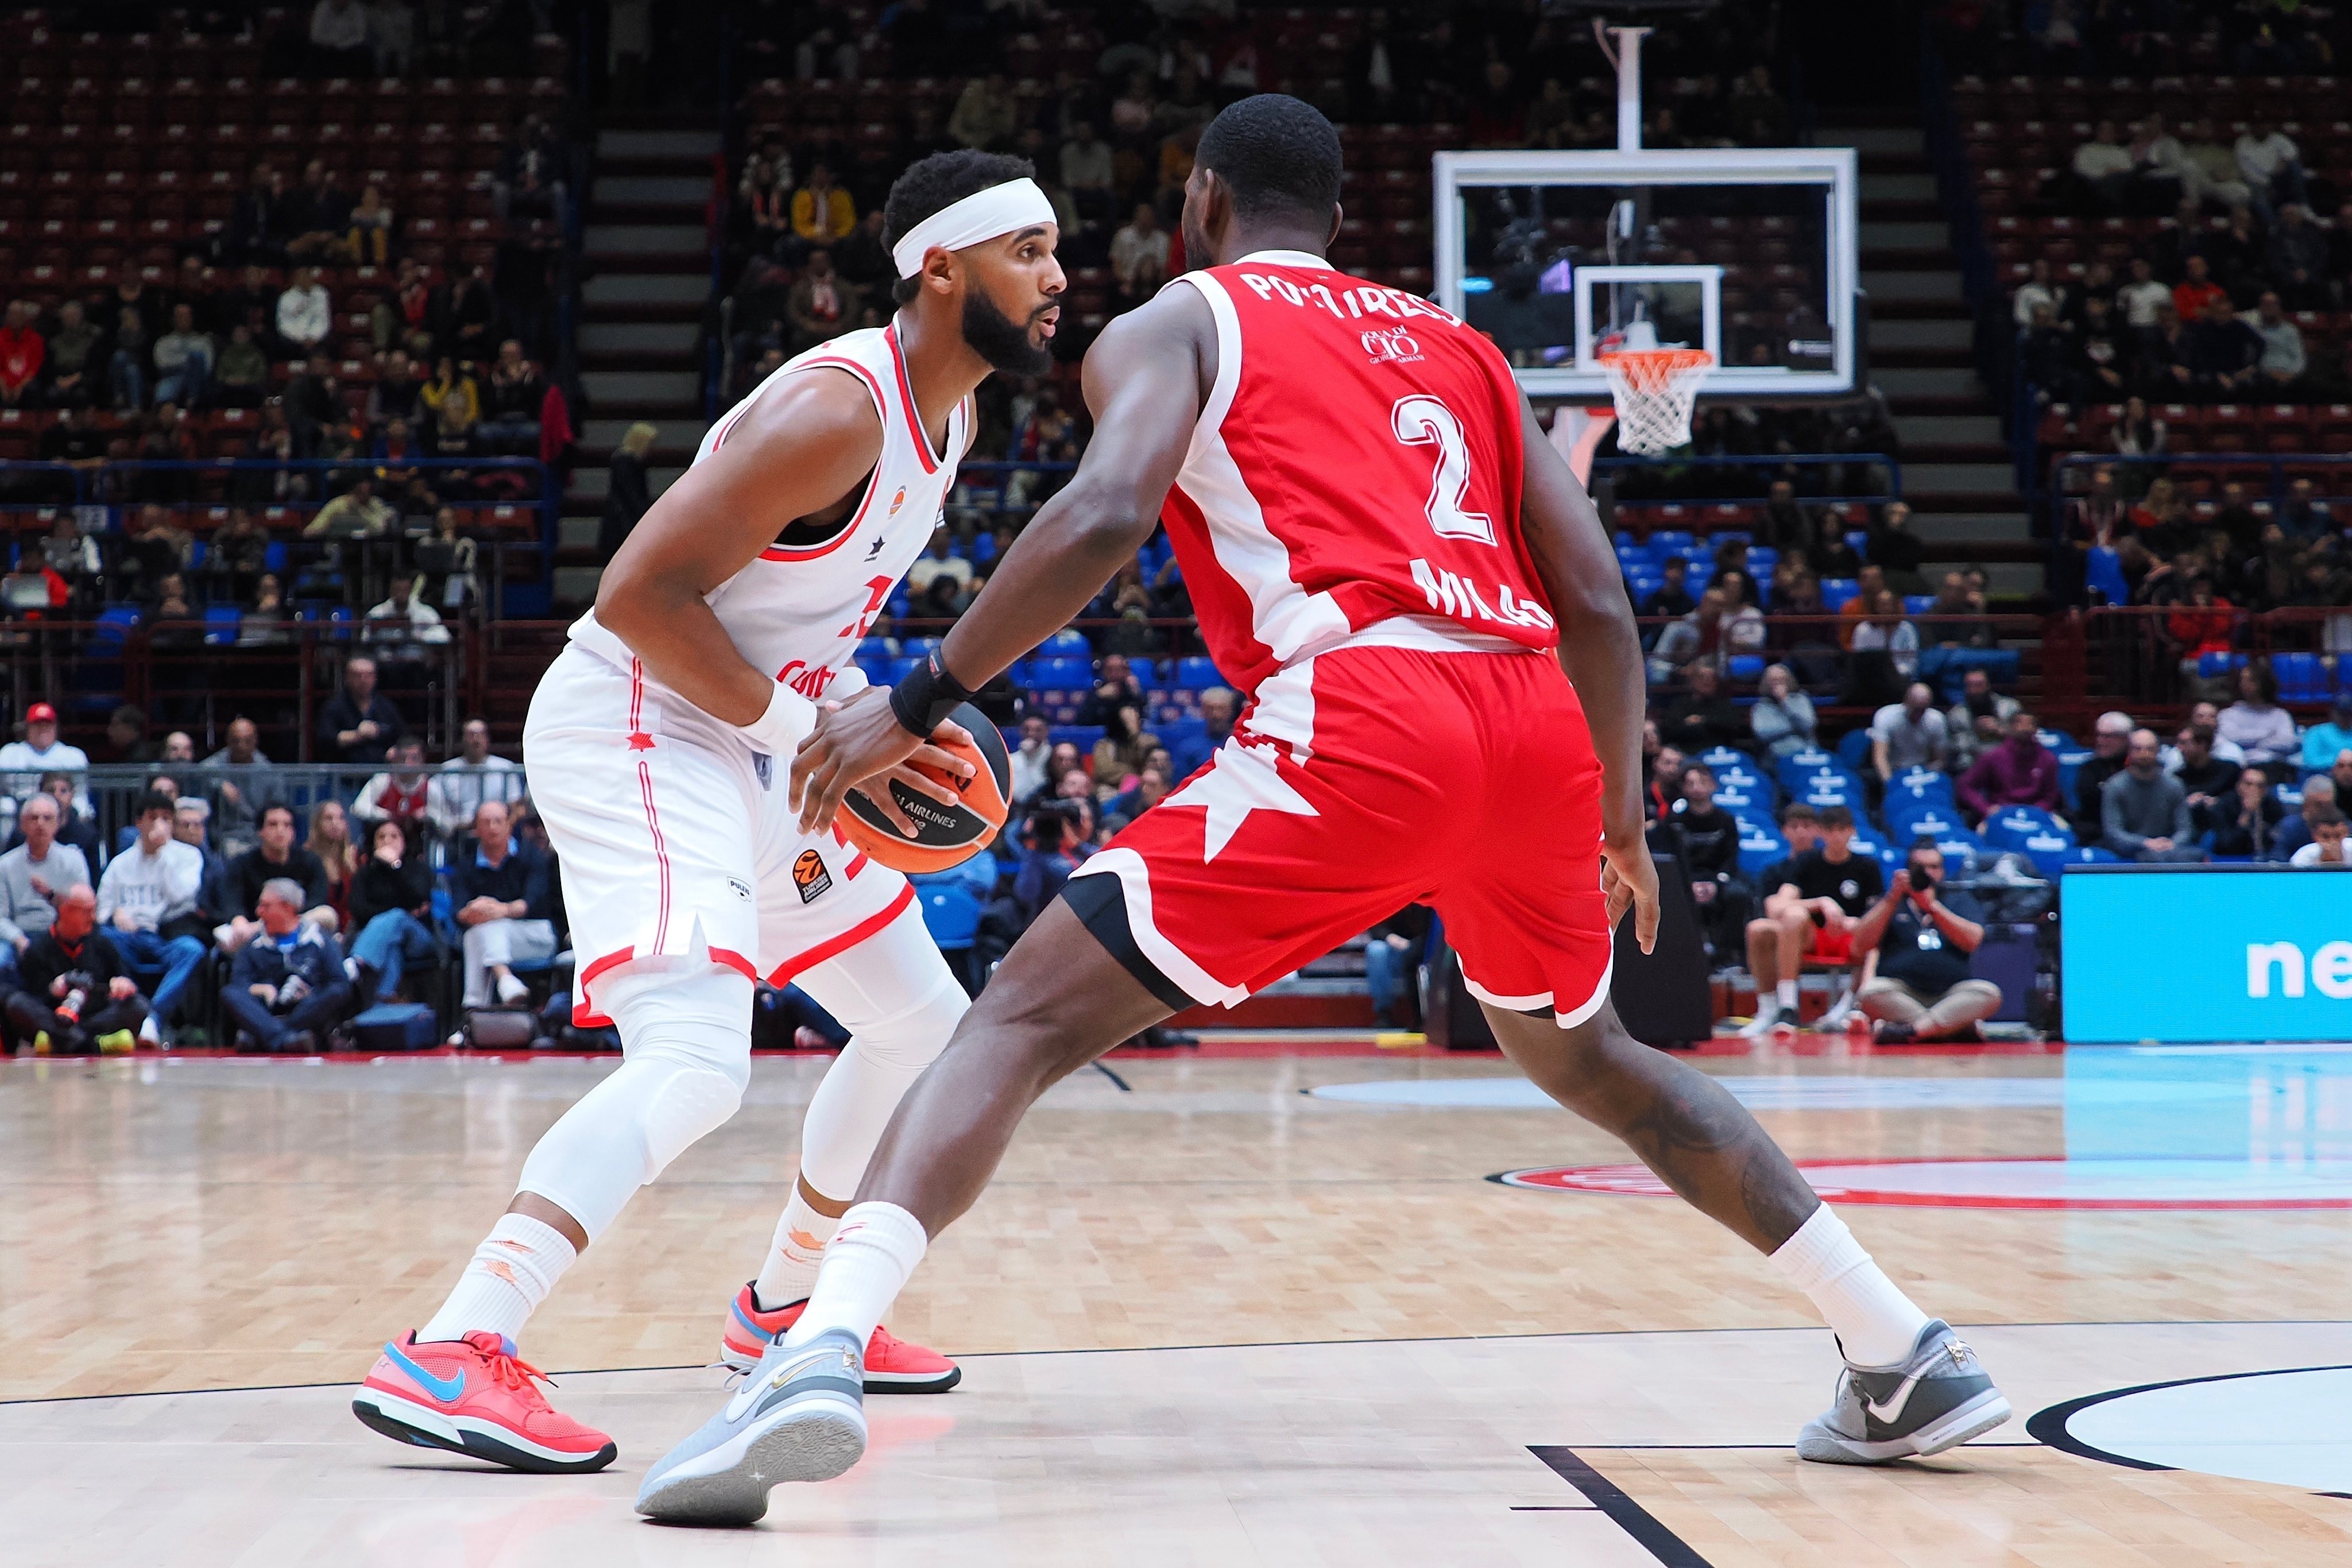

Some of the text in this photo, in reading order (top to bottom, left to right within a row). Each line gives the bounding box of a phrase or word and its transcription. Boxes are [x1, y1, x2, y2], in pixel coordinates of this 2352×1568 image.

[1391, 394, 1499, 547] 2
[905, 802, 957, 828] AIRLINES
[2246, 940, 2352, 1000] ne
